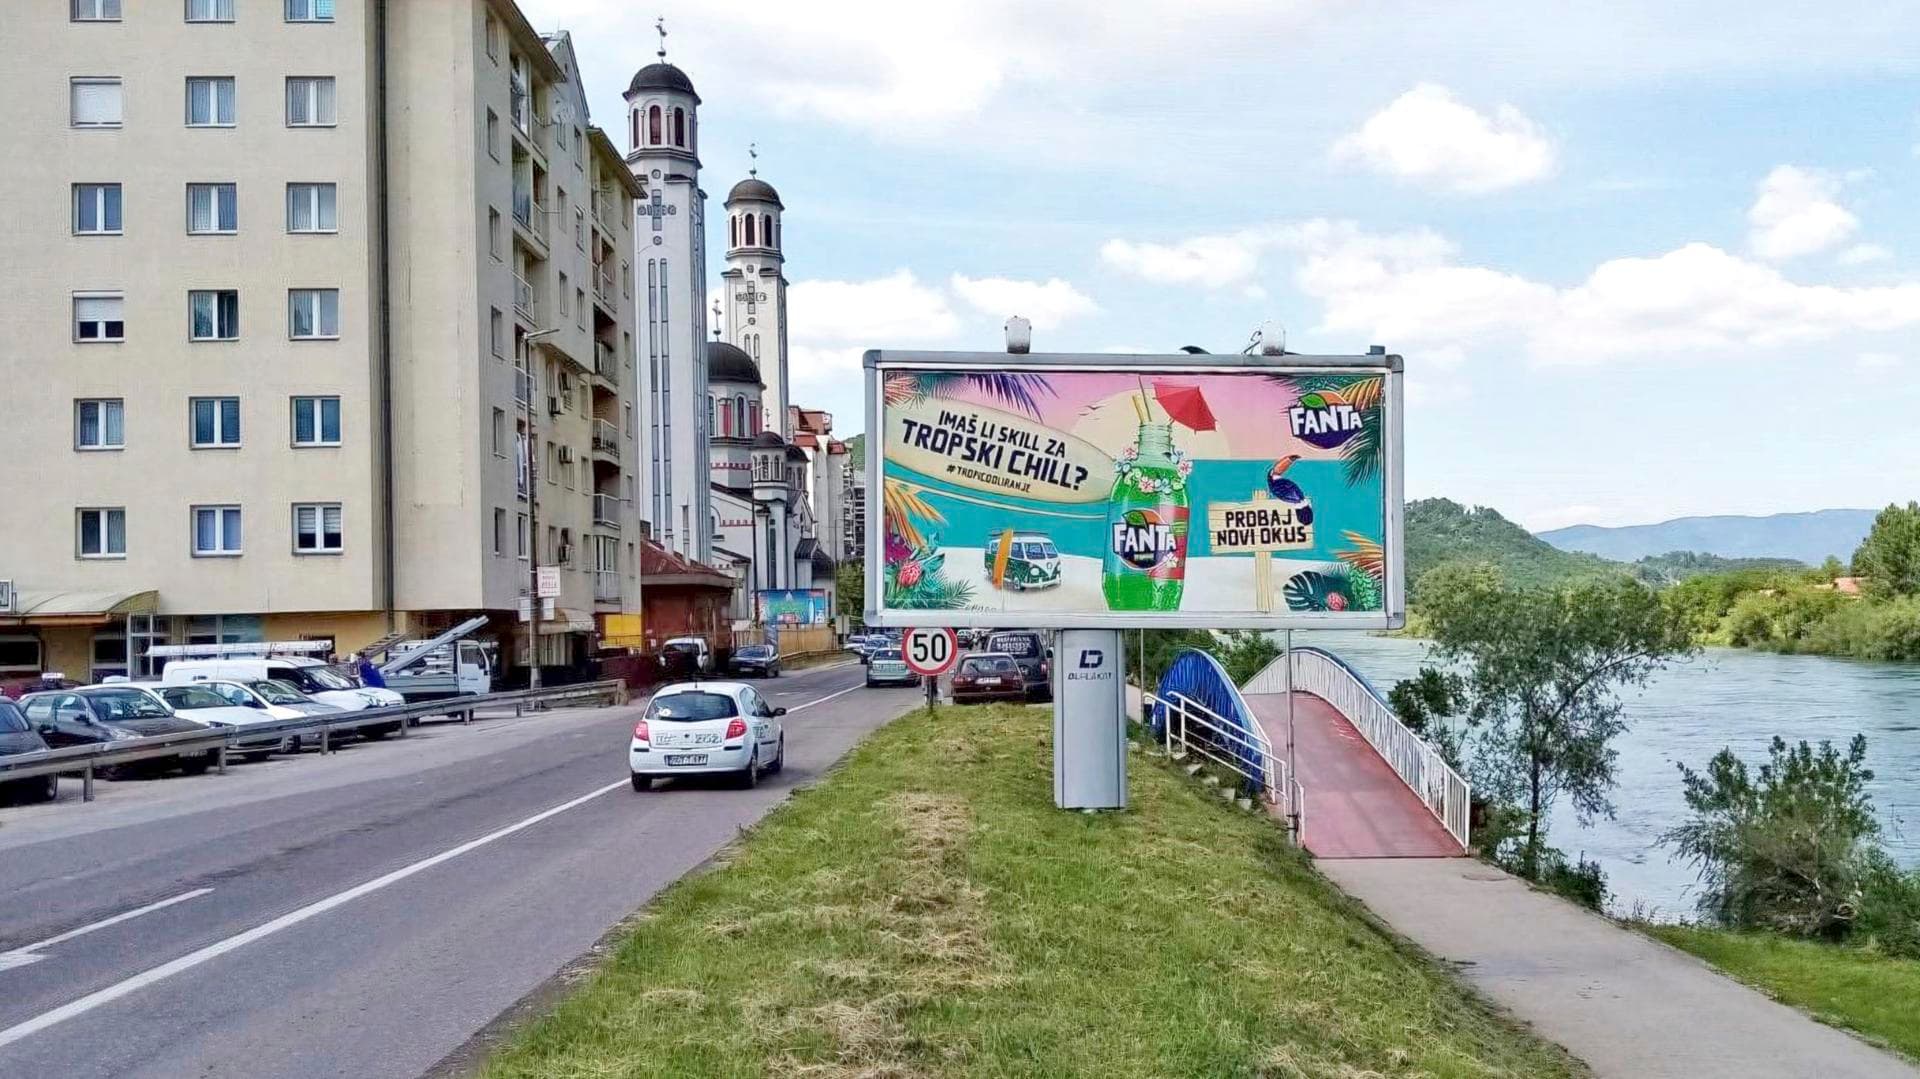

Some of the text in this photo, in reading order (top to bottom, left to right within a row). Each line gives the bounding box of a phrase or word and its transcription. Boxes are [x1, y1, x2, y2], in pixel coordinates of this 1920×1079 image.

[938, 410, 1066, 458] IMAŠ LI SKILL ZA
[1290, 404, 1363, 435] FANTA
[902, 418, 1089, 491] TROPSKI CHILL?
[1225, 508, 1292, 528] PROBAJ
[1113, 524, 1177, 552] FANTA
[1217, 526, 1307, 546] NOVI OKUS
[912, 633, 946, 662] 50
